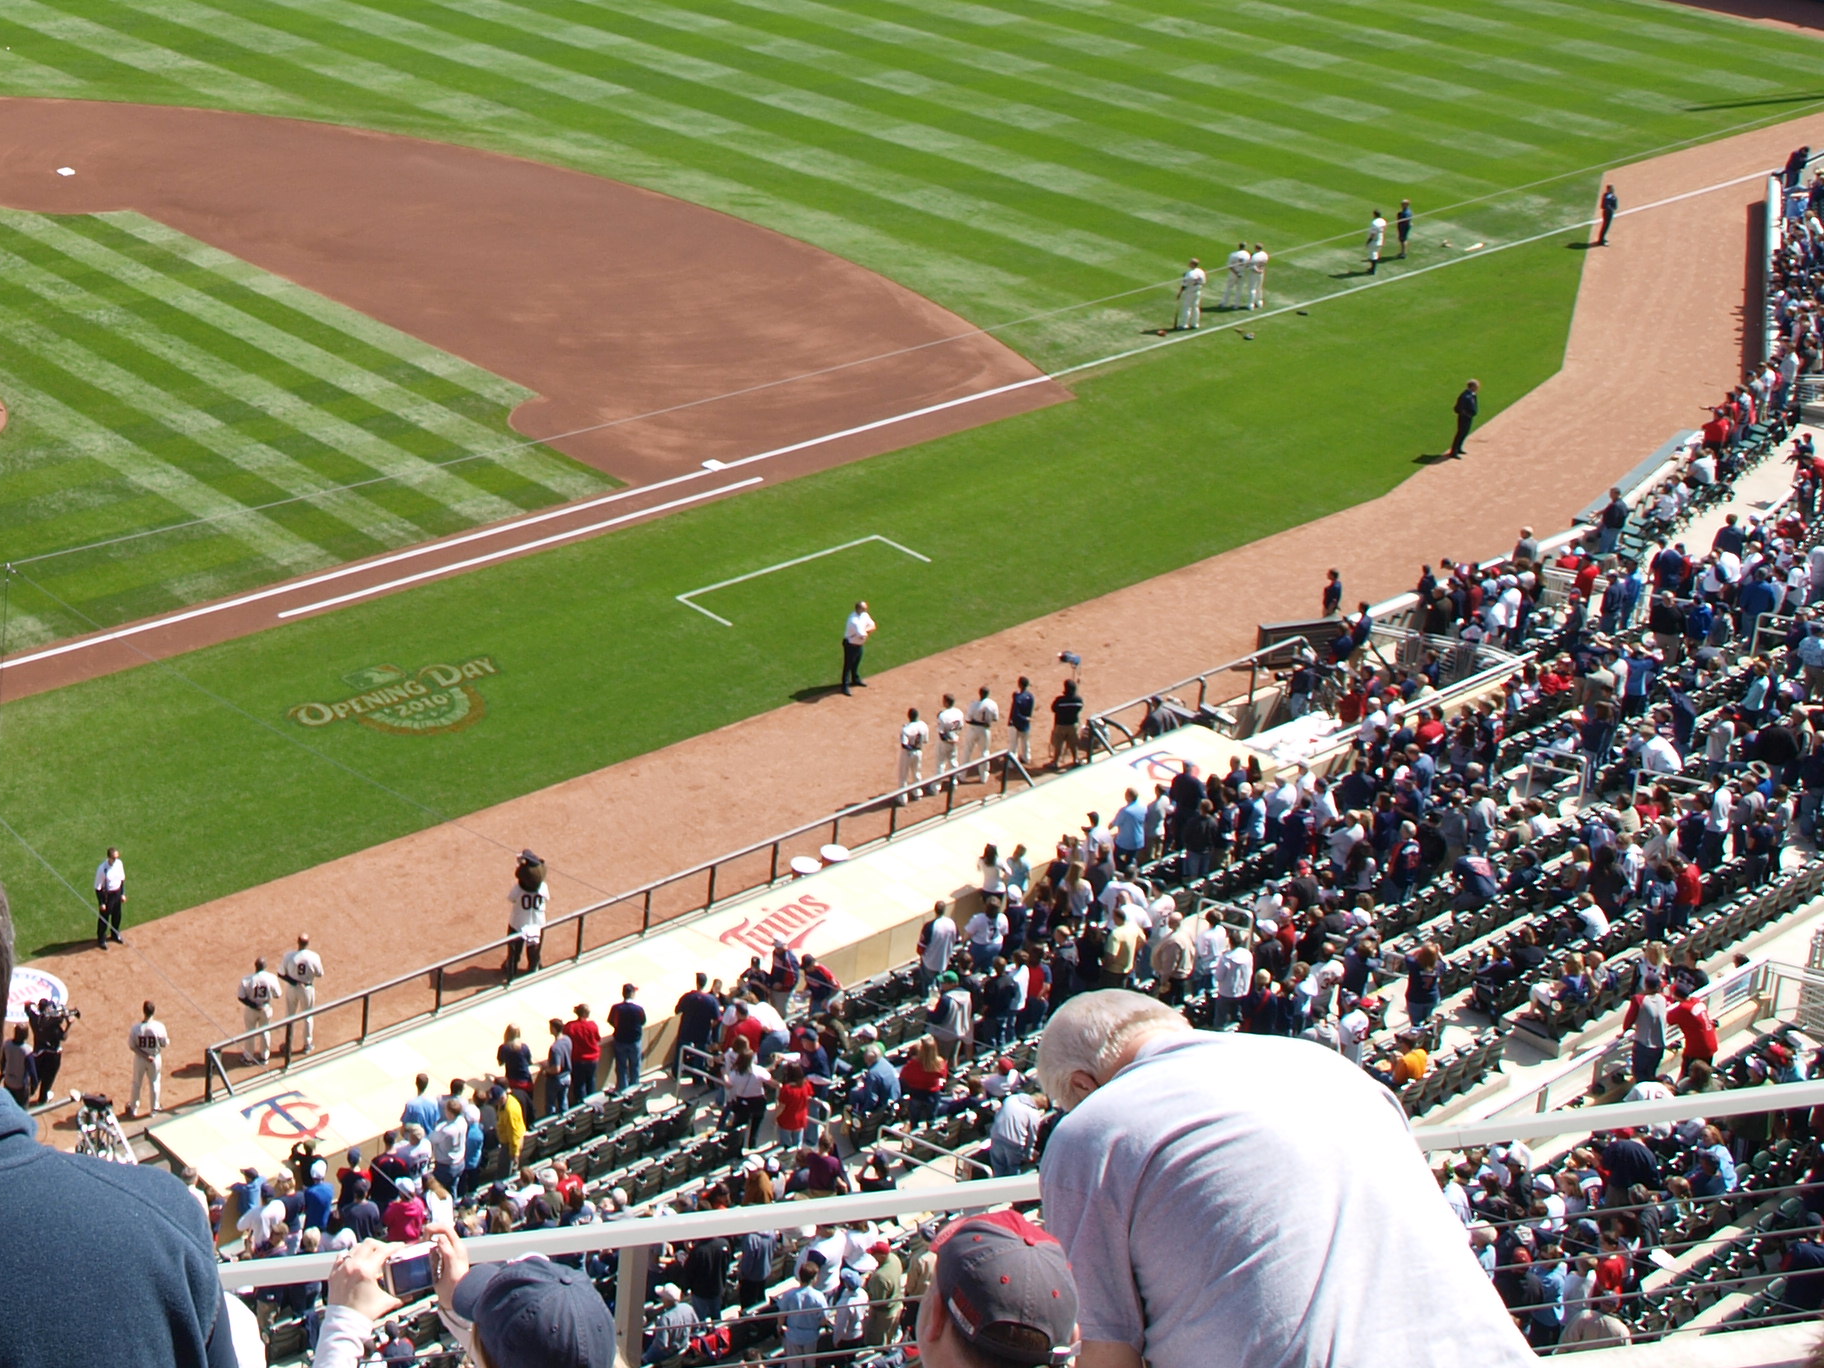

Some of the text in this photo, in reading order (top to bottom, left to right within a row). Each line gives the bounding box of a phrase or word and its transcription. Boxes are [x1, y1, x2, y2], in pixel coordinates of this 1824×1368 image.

[287, 656, 497, 726] OPENING DAY
[521, 893, 542, 910] 00
[719, 894, 831, 958] Twins
